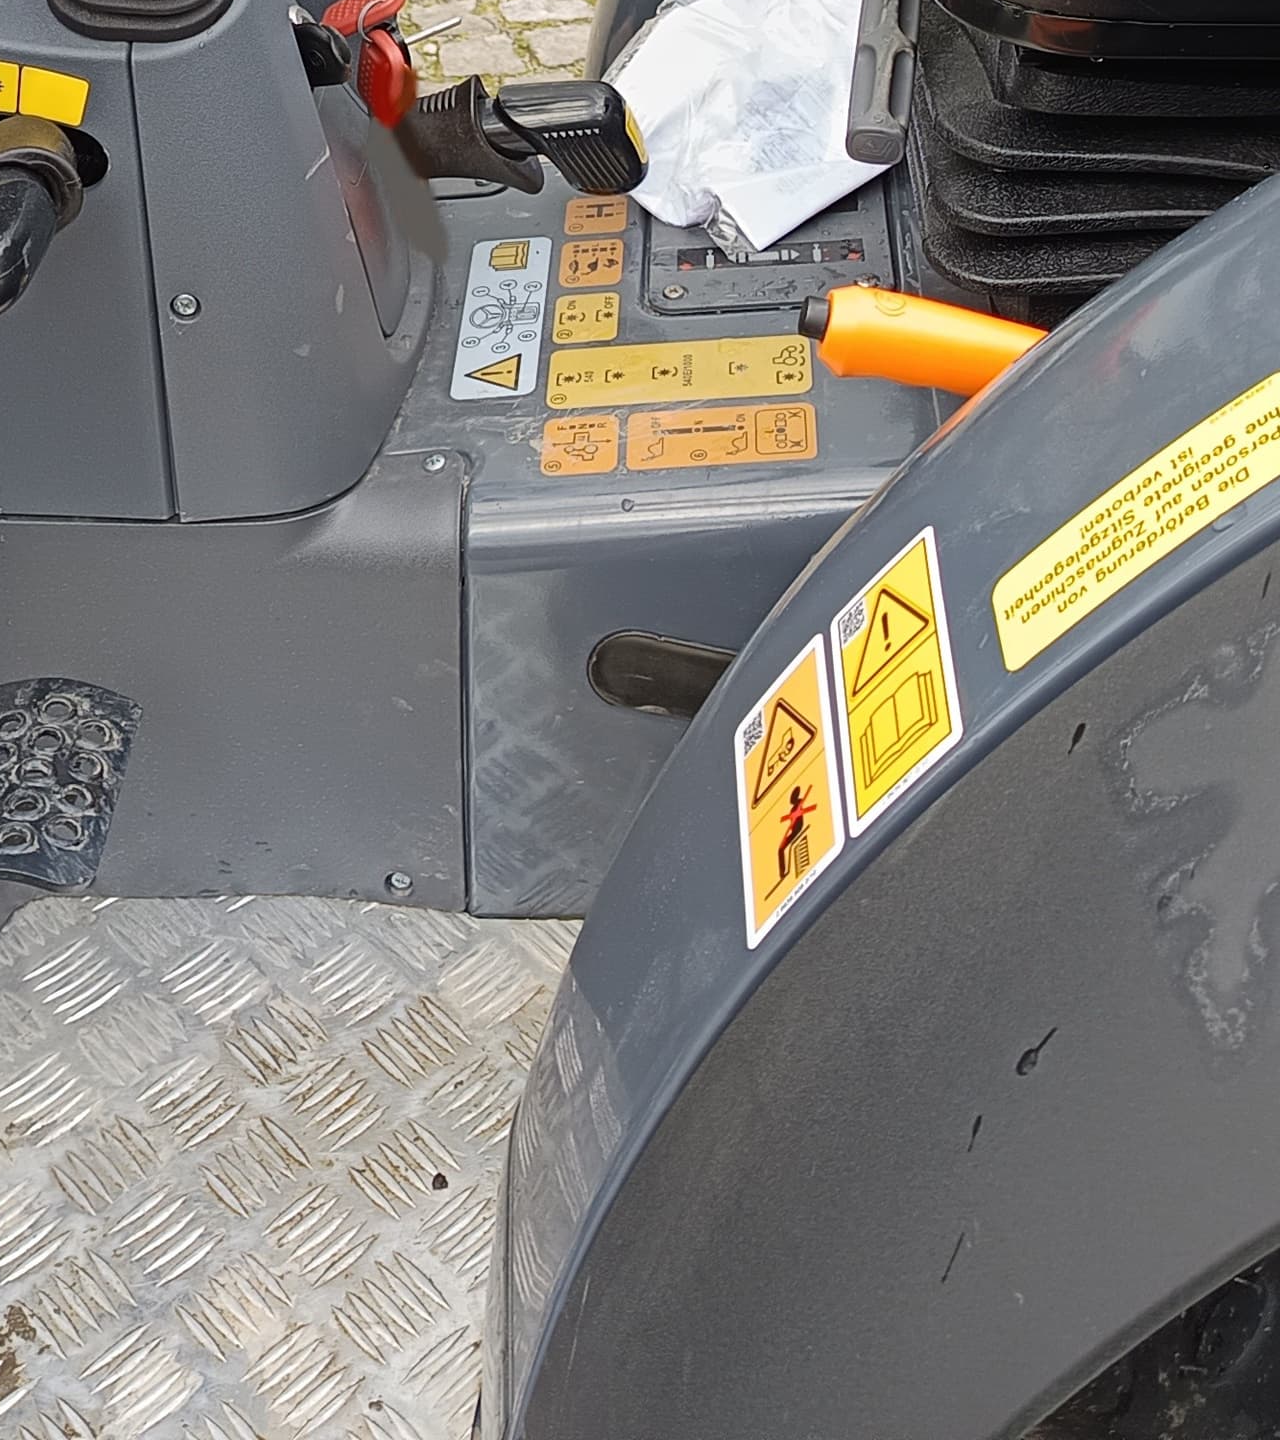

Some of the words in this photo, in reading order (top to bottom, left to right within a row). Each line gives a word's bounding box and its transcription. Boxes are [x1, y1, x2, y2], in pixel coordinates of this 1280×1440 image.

[567, 300, 577, 311] ON
[603, 295, 614, 310] OFF
[1143, 434, 1237, 507] geeignete
[1169, 447, 1194, 470] ist
[1217, 466, 1250, 493] Die
[1079, 470, 1163, 540] verboten!
[1155, 492, 1183, 523] auf
[1095, 494, 1210, 583] Beförderung
[1003, 509, 1136, 621] Sitzgelegenheit
[1020, 520, 1148, 624] Zugmaschinen
[1056, 585, 1088, 613] von
